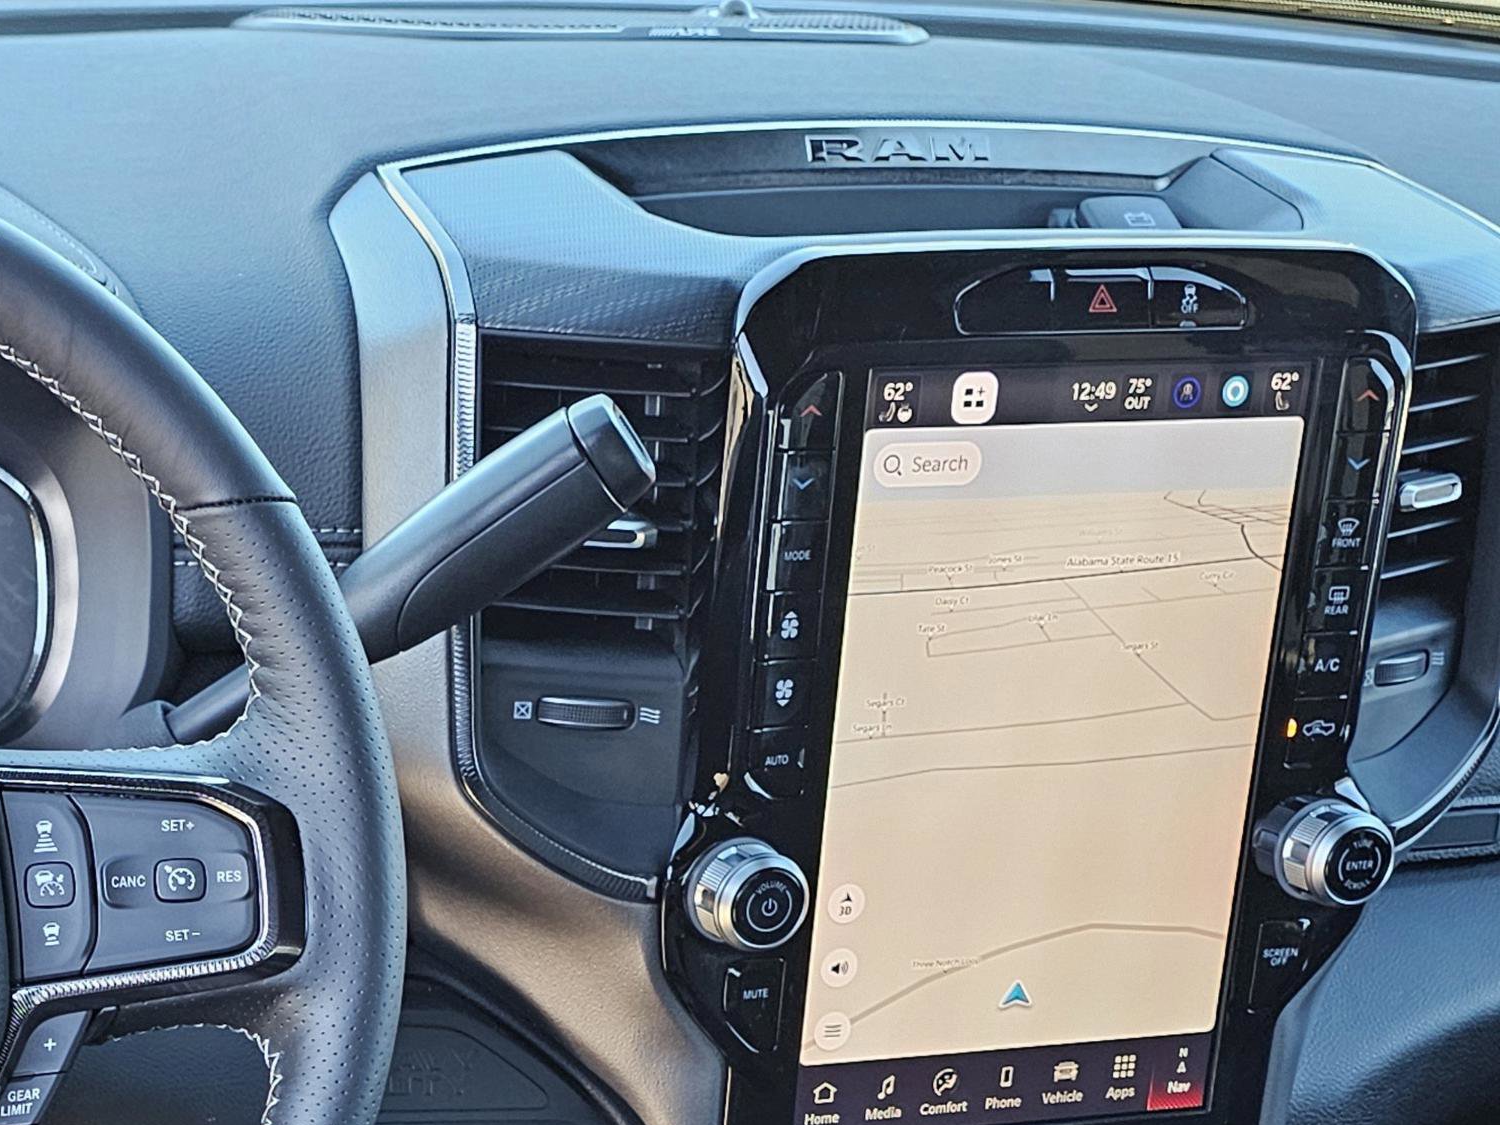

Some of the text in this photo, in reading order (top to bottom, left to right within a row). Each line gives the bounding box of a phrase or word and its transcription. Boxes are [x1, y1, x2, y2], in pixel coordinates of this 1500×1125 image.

[804, 134, 990, 163] RAM
[1071, 381, 1116, 401] 12:49
[1124, 394, 1151, 411] OUT
[911, 453, 969, 474] Search
[1331, 537, 1361, 549] FRONT
[784, 550, 811, 561] MODE
[1066, 557, 1110, 568] Alabama
[1111, 555, 1134, 566] State
[1137, 554, 1165, 564] Route
[1324, 604, 1349, 616] REAR
[1314, 657, 1341, 673] A/C
[765, 754, 789, 766] AUTO
[1346, 860, 1374, 871] ENTER
[111, 874, 146, 890] CANC
[216, 870, 242, 884] RES
[755, 880, 788, 895] VOLUME
[839, 905, 852, 917] 3D
[1263, 947, 1298, 959] SCREEN
[1270, 956, 1287, 967] OFF
[743, 988, 769, 1000] MUTE
[1105, 1085, 1135, 1101] Apps
[1167, 1080, 1191, 1094] Nav
[7, 1088, 40, 1102] GEAR
[984, 1094, 1022, 1110] Phone
[1042, 1090, 1083, 1105] Vehicle
[1, 1102, 32, 1117] LIMIT
[865, 1106, 902, 1121] Media
[920, 1100, 968, 1116] Comfort
[804, 1111, 840, 1125] Home
